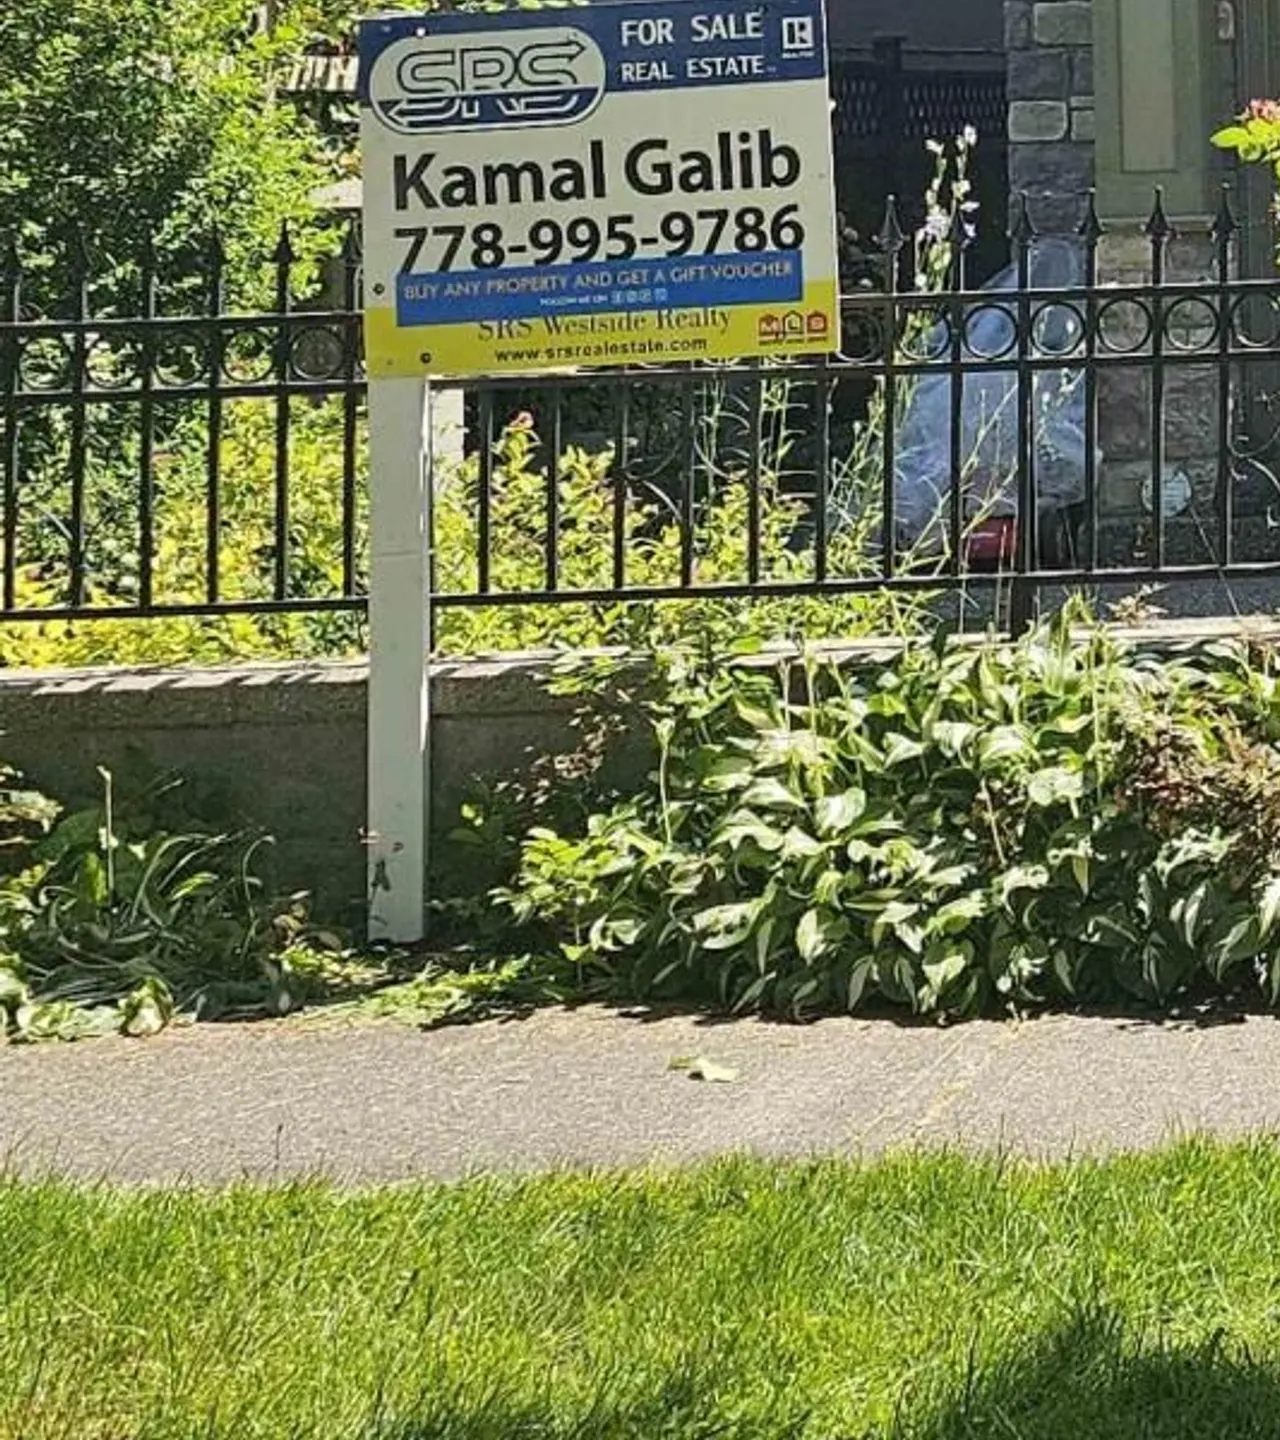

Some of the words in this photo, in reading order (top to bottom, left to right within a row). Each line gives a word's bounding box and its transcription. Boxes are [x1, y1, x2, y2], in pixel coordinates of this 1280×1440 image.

[621, 18, 674, 46] FOR
[691, 10, 764, 42] SALE
[388, 41, 587, 127] SRS
[621, 62, 676, 83] REAL
[687, 55, 765, 78] ESTATE
[392, 140, 606, 211] Kamal
[624, 129, 801, 196] Galib
[394, 203, 806, 274] 778-995-9786
[404, 284, 440, 301] BUY
[443, 280, 481, 298] ANY
[486, 273, 568, 294] PROPERTY
[574, 272, 613, 289] AND
[616, 268, 649, 286] GET
[653, 267, 666, 283] A
[670, 263, 708, 283] GIFT
[711, 260, 793, 279] VOUCHER
[478, 319, 533, 341] SRS
[545, 313, 646, 336] Westside
[656, 307, 731, 334] Realty
[496, 337, 707, 362] www.srsrealestate.com
